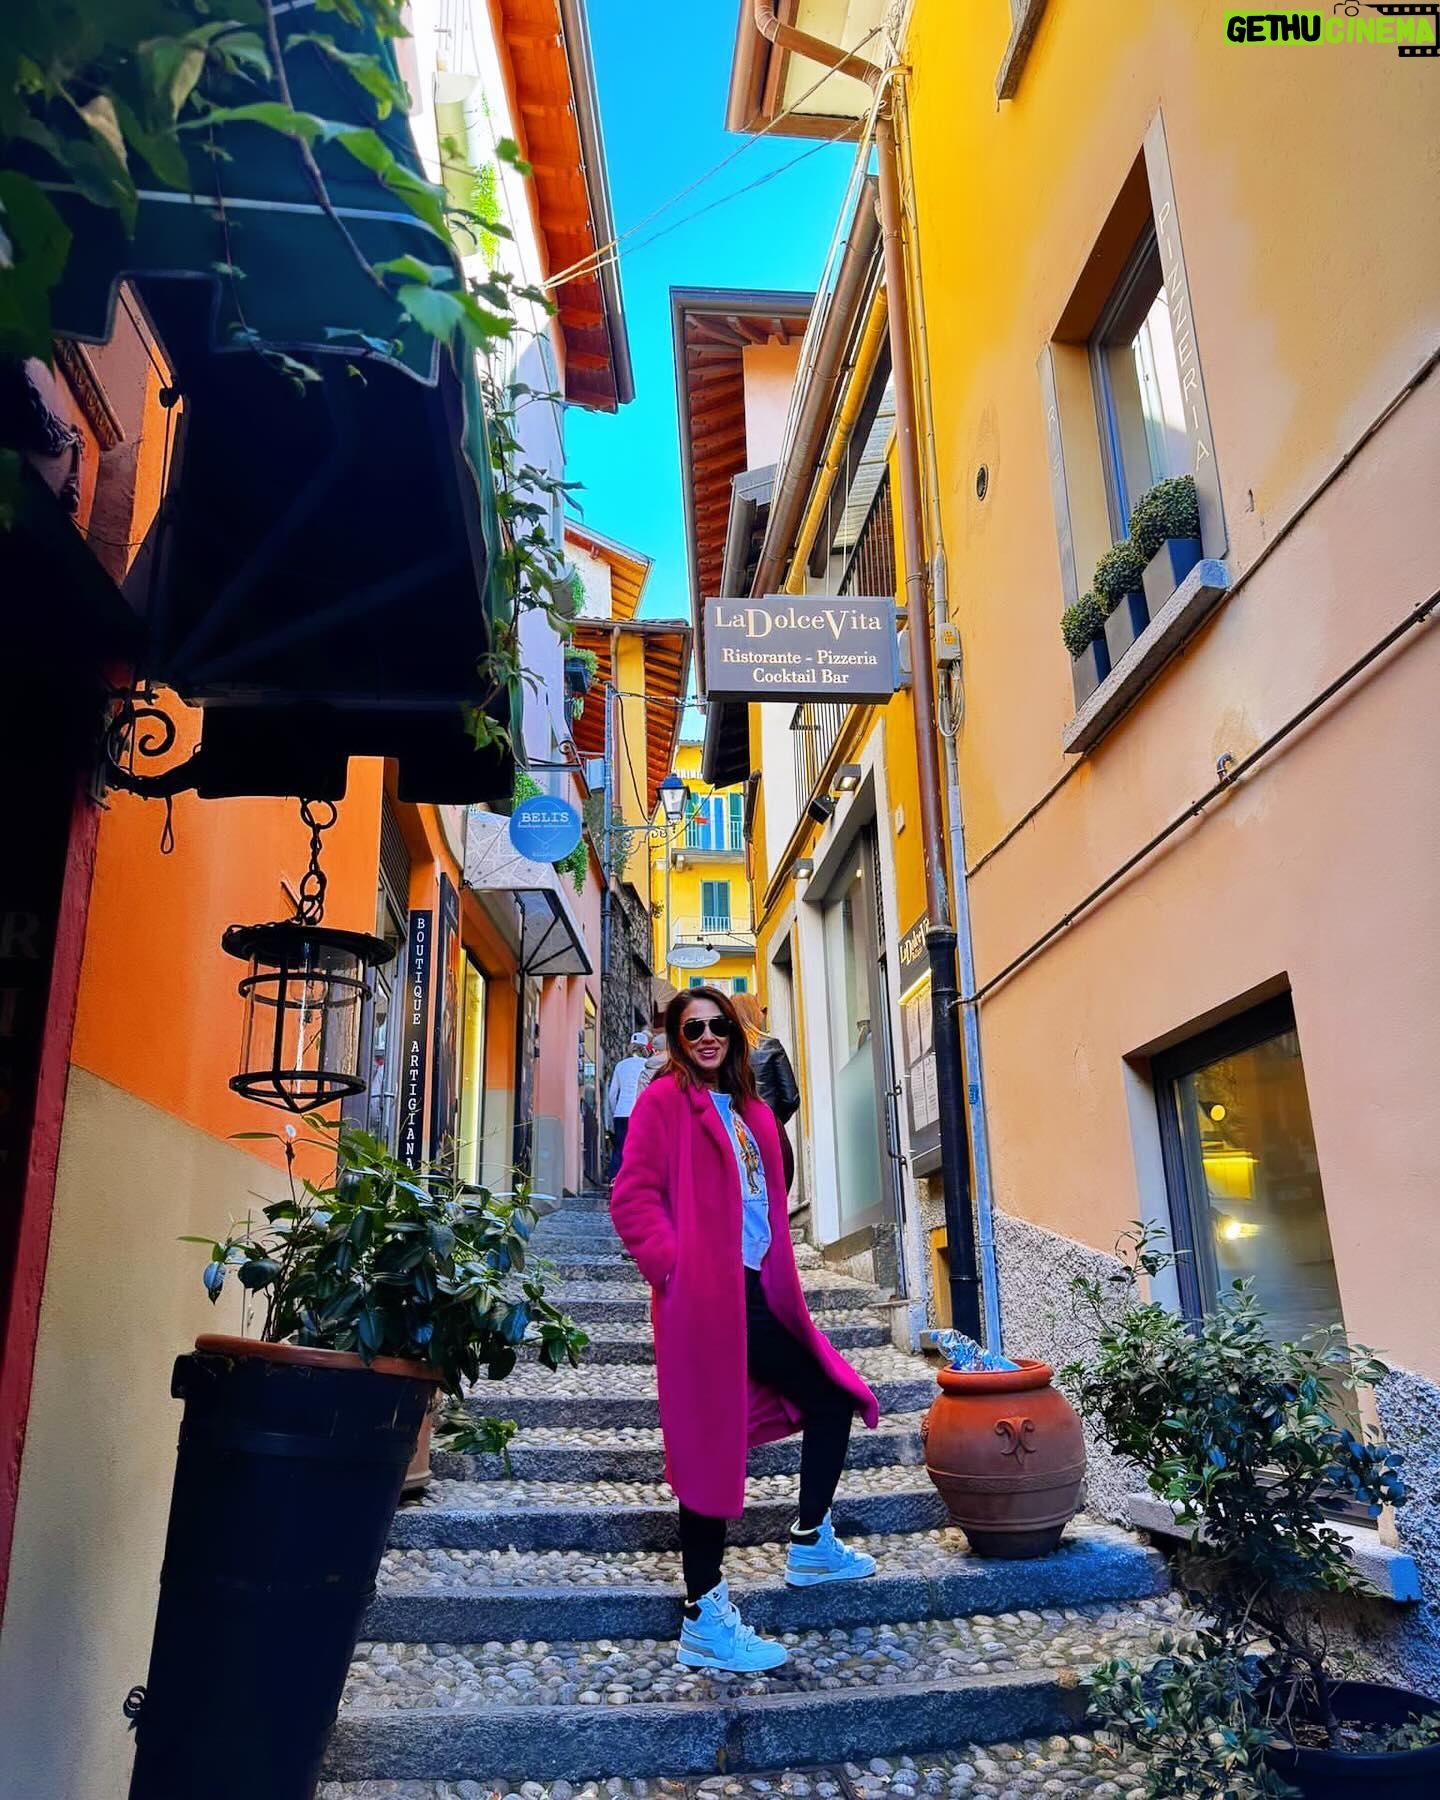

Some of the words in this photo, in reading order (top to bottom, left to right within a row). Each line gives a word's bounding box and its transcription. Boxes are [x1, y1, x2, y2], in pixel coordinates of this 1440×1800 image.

[721, 647, 802, 665] Ristorante
[816, 649, 878, 665] Pizzeria
[752, 667, 816, 684] Cocktail
[821, 670, 850, 684] Bar
[520, 811, 570, 823] BELIS
[412, 917, 426, 1025] BOUTIQUE
